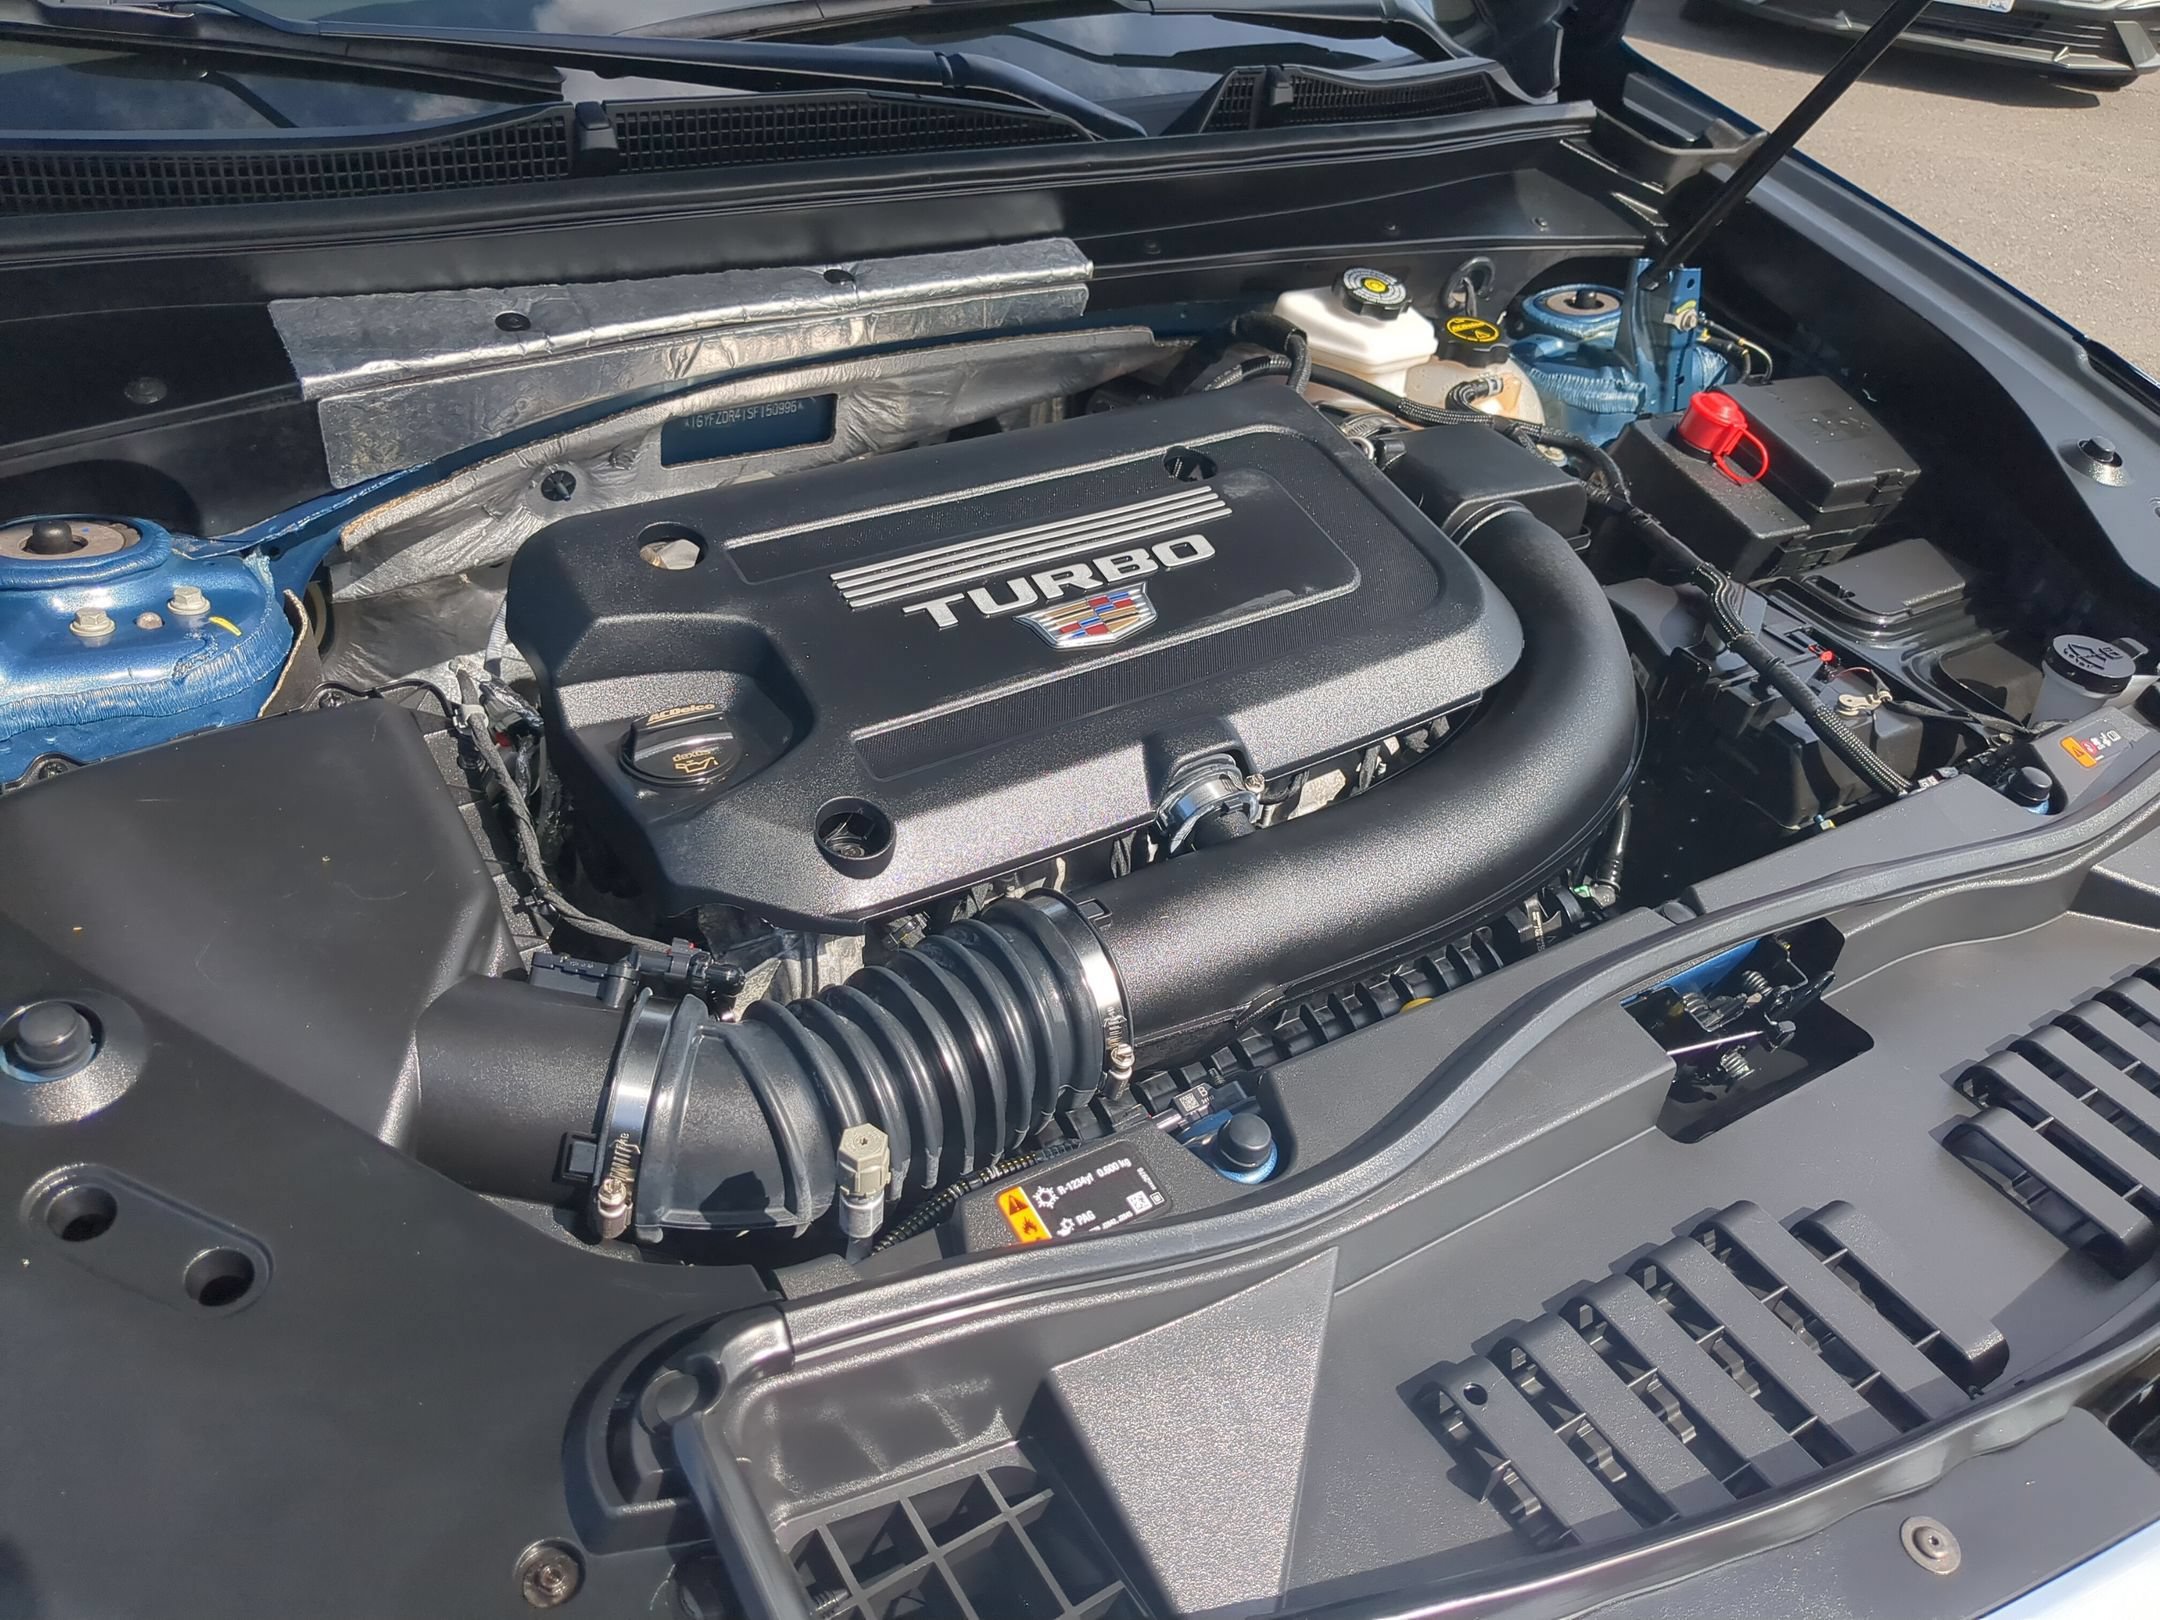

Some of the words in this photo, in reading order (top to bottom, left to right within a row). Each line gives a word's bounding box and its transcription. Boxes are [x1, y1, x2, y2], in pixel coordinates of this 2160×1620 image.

[902, 534, 1215, 628] TURBO
[647, 703, 716, 723] ACDelco
[1197, 1086, 1208, 1097] B
[1119, 1157, 1132, 1169] kg
[1075, 1210, 1097, 1226] PAG
